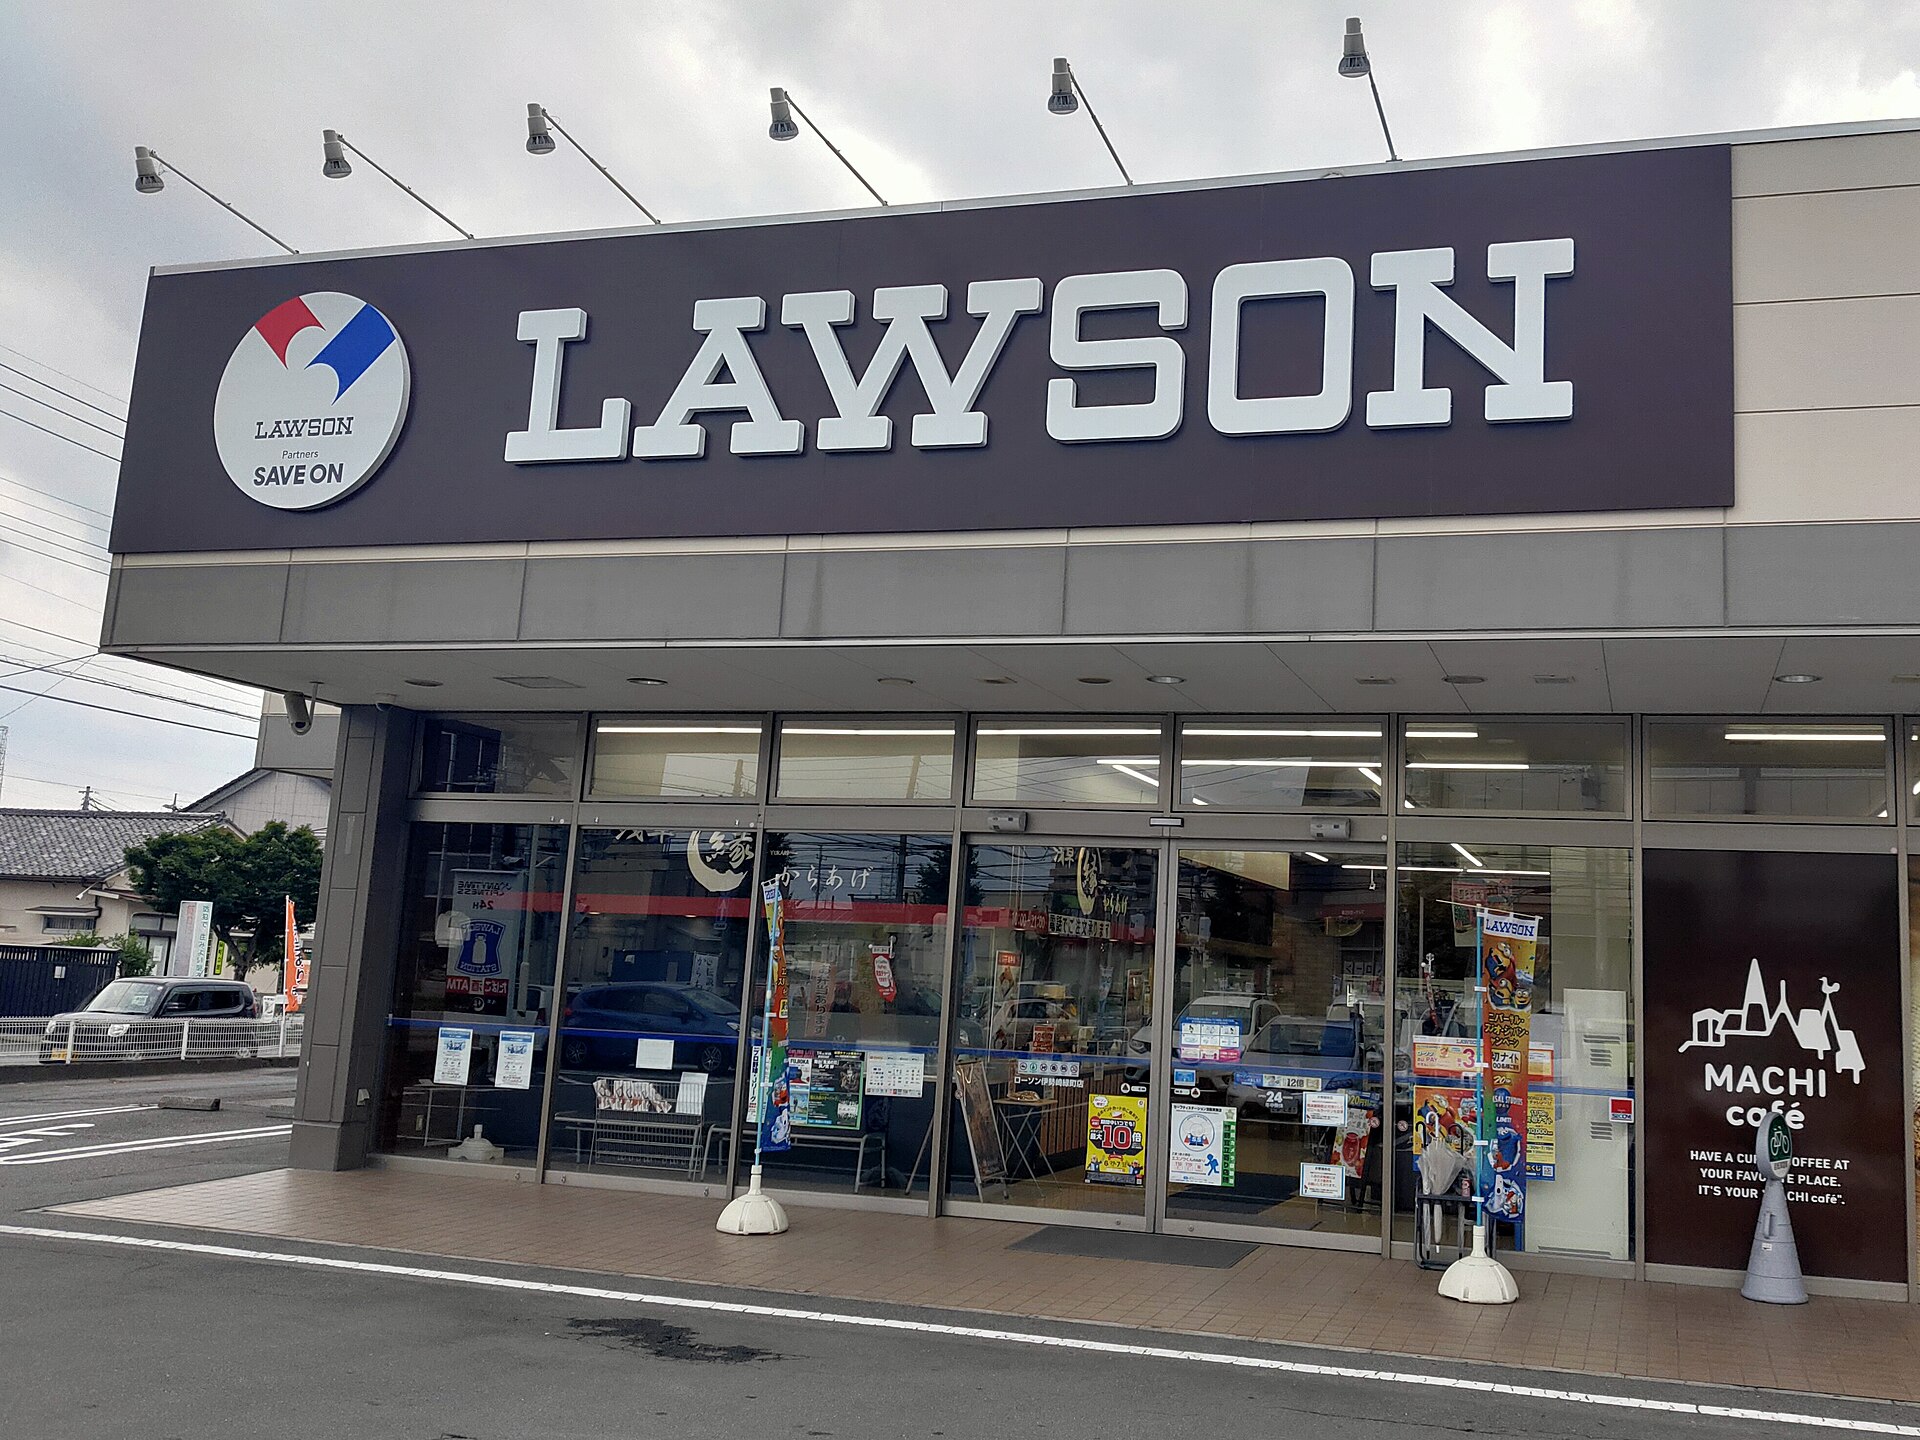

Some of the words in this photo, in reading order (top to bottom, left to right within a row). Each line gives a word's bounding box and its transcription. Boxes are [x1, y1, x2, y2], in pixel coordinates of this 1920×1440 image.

[504, 238, 1576, 465] LAWSON
[254, 416, 354, 439] LAWSON
[282, 449, 319, 459] Partners
[253, 465, 306, 486] SAVE
[309, 463, 344, 483] ON
[780, 864, 874, 891] からあげ
[1486, 919, 1535, 937] LAWSON
[1463, 1048, 1475, 1068] 3
[1705, 1063, 1826, 1098] MACHI
[1266, 1091, 1283, 1103] 24
[1102, 1125, 1132, 1149] 10
[1690, 1150, 1722, 1162] HAVE
[1725, 1153, 1734, 1163] A
[1736, 1153, 1757, 1165] CU
[1791, 1157, 1831, 1169] OFFEE
[1833, 1160, 1850, 1171] AT
[1700, 1168, 1733, 1180] YOUR
[1798, 1174, 1841, 1187] PLACE.
[1698, 1185, 1721, 1196] IT'S
[1725, 1187, 1758, 1199] YOUR
